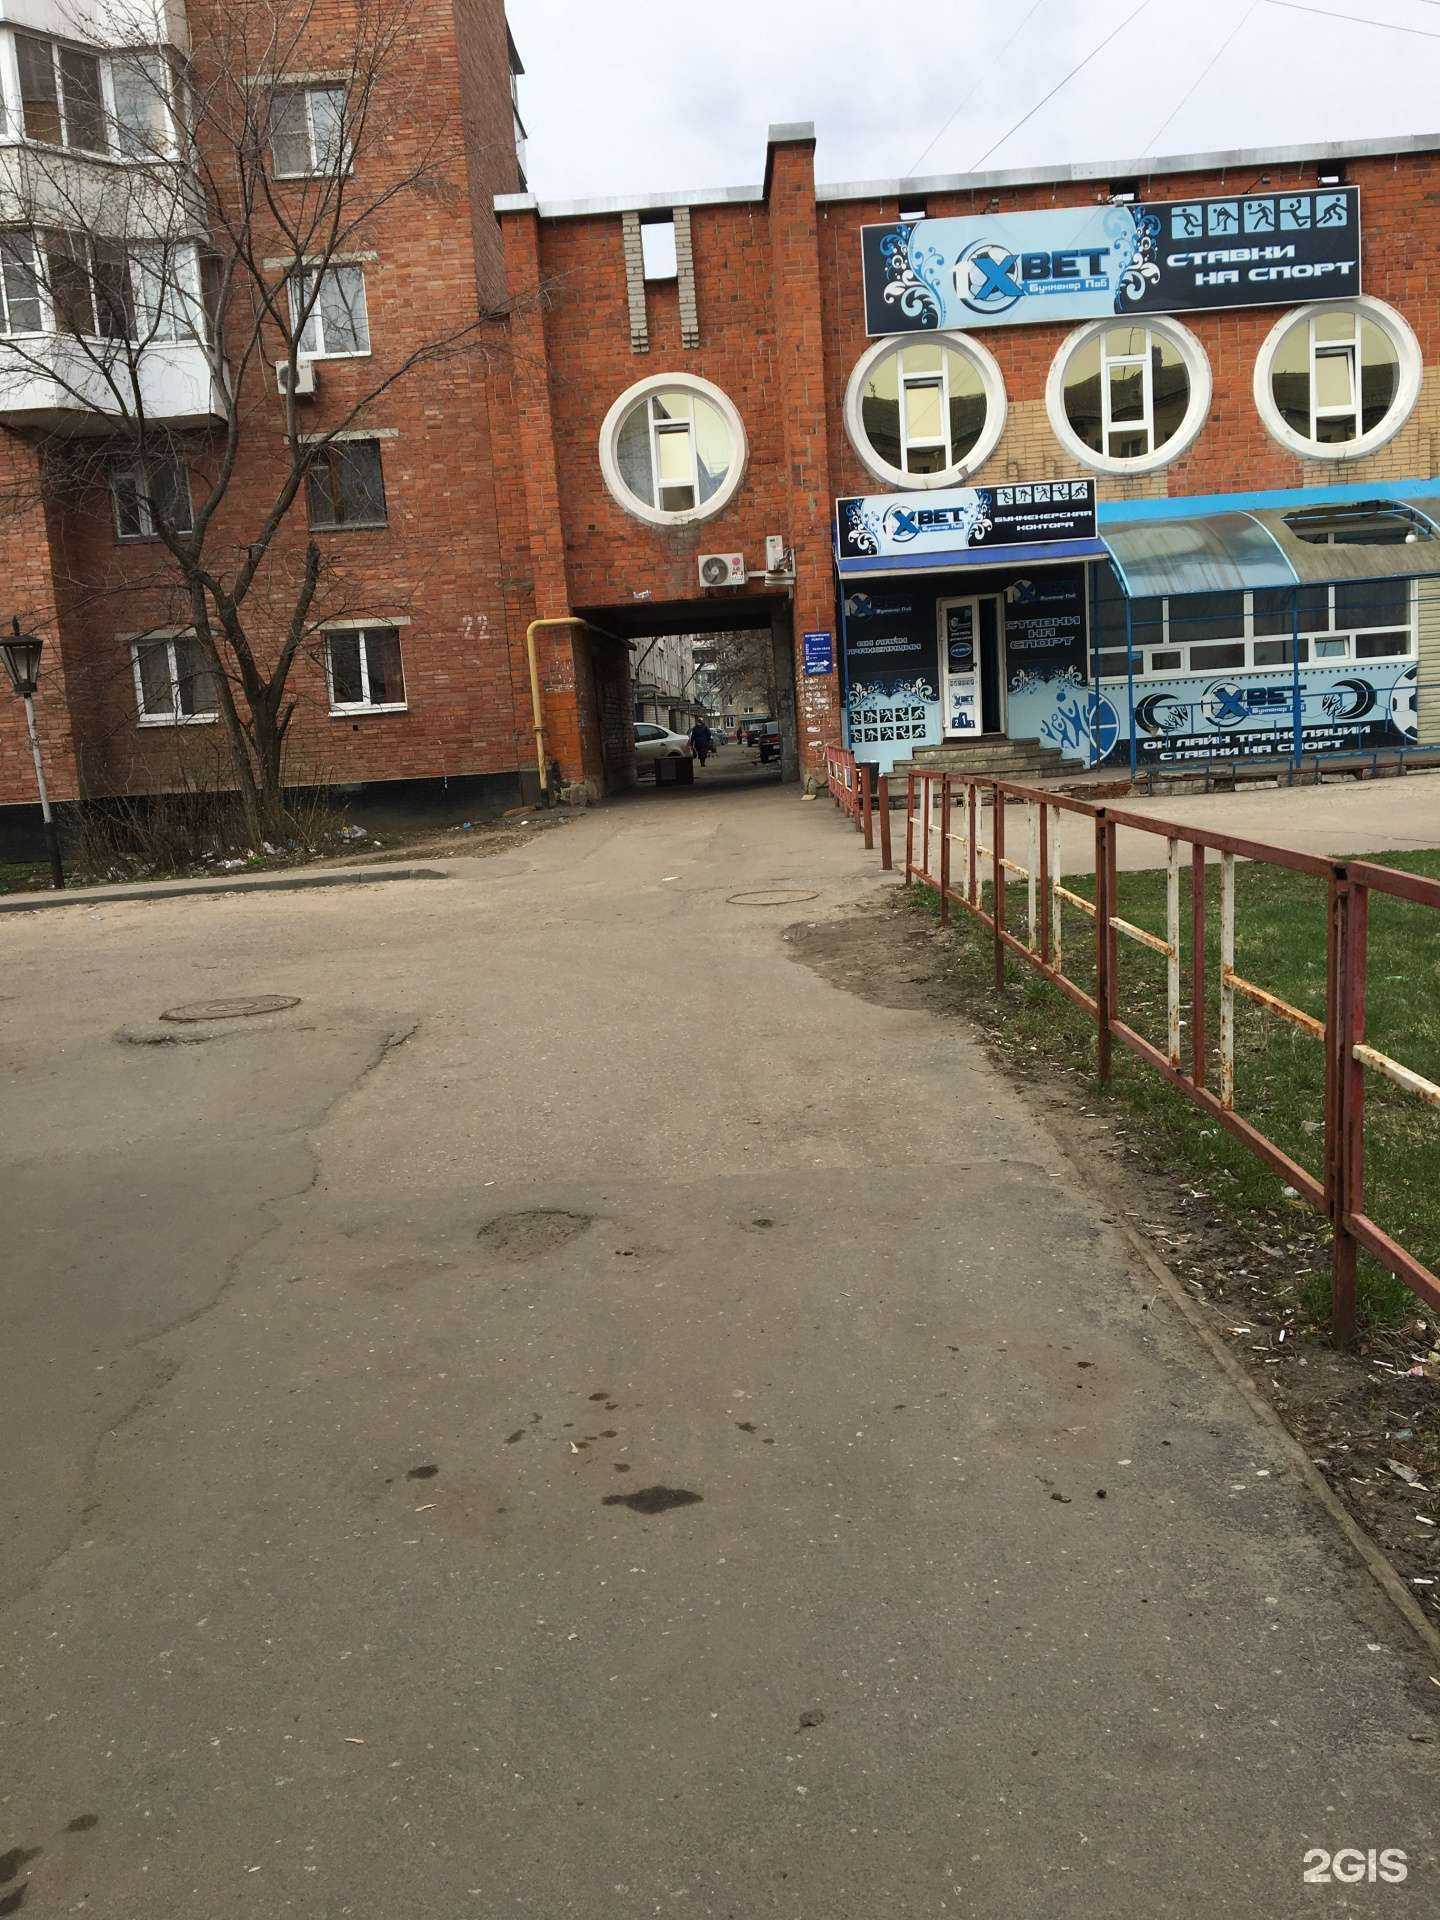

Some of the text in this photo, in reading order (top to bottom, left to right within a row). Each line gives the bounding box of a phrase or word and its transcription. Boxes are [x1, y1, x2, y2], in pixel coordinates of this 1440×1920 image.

[1166, 245, 1296, 267] СТАВКИ
[1195, 261, 1357, 286] НА СПОРТ
[1085, 278, 1107, 288] Паб
[994, 511, 1092, 523] БУКМЕКЕРСКАЯ
[1016, 521, 1074, 531] КОНТОРА
[1028, 627, 1056, 638] НА
[1010, 636, 1075, 649] СПОРТ
[1143, 741, 1171, 750] ОН
[1176, 734, 1230, 747] ЛАЙН
[1160, 747, 1239, 760] СТАВКИ
[1244, 744, 1271, 754] НА
